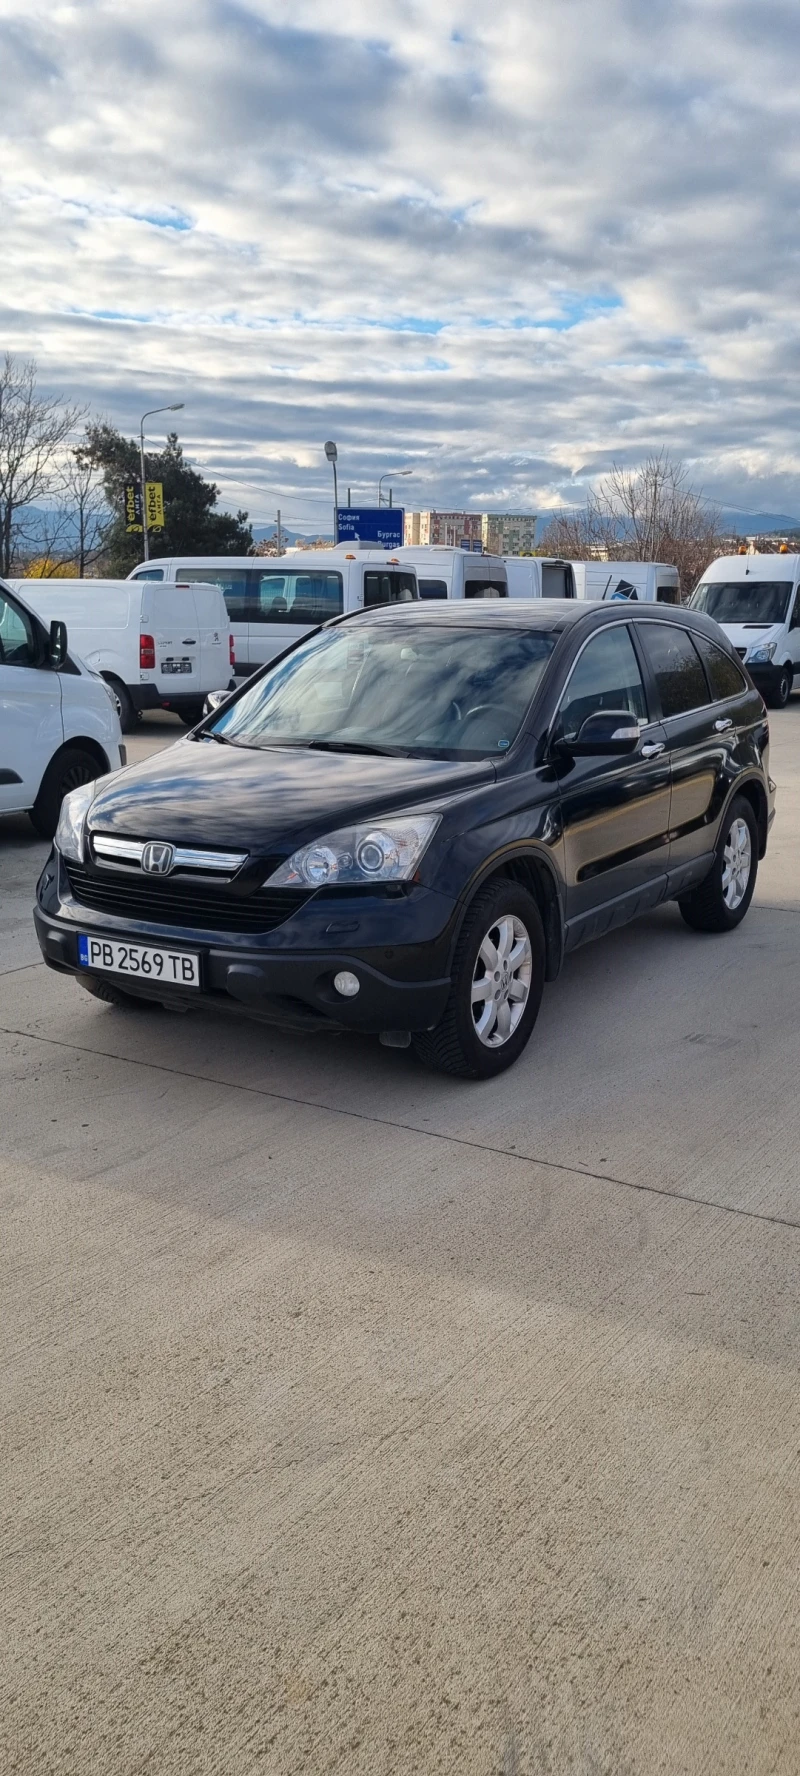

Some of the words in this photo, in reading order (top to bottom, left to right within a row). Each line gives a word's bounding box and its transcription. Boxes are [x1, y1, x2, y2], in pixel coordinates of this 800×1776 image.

[126, 486, 135, 521] efbet
[148, 486, 157, 521] efbet
[338, 513, 360, 521] София
[338, 523, 355, 531] Sofia
[377, 530, 400, 539] Бургас
[90, 941, 114, 967] PB
[118, 946, 164, 976] 2569
[168, 954, 195, 982] TB
